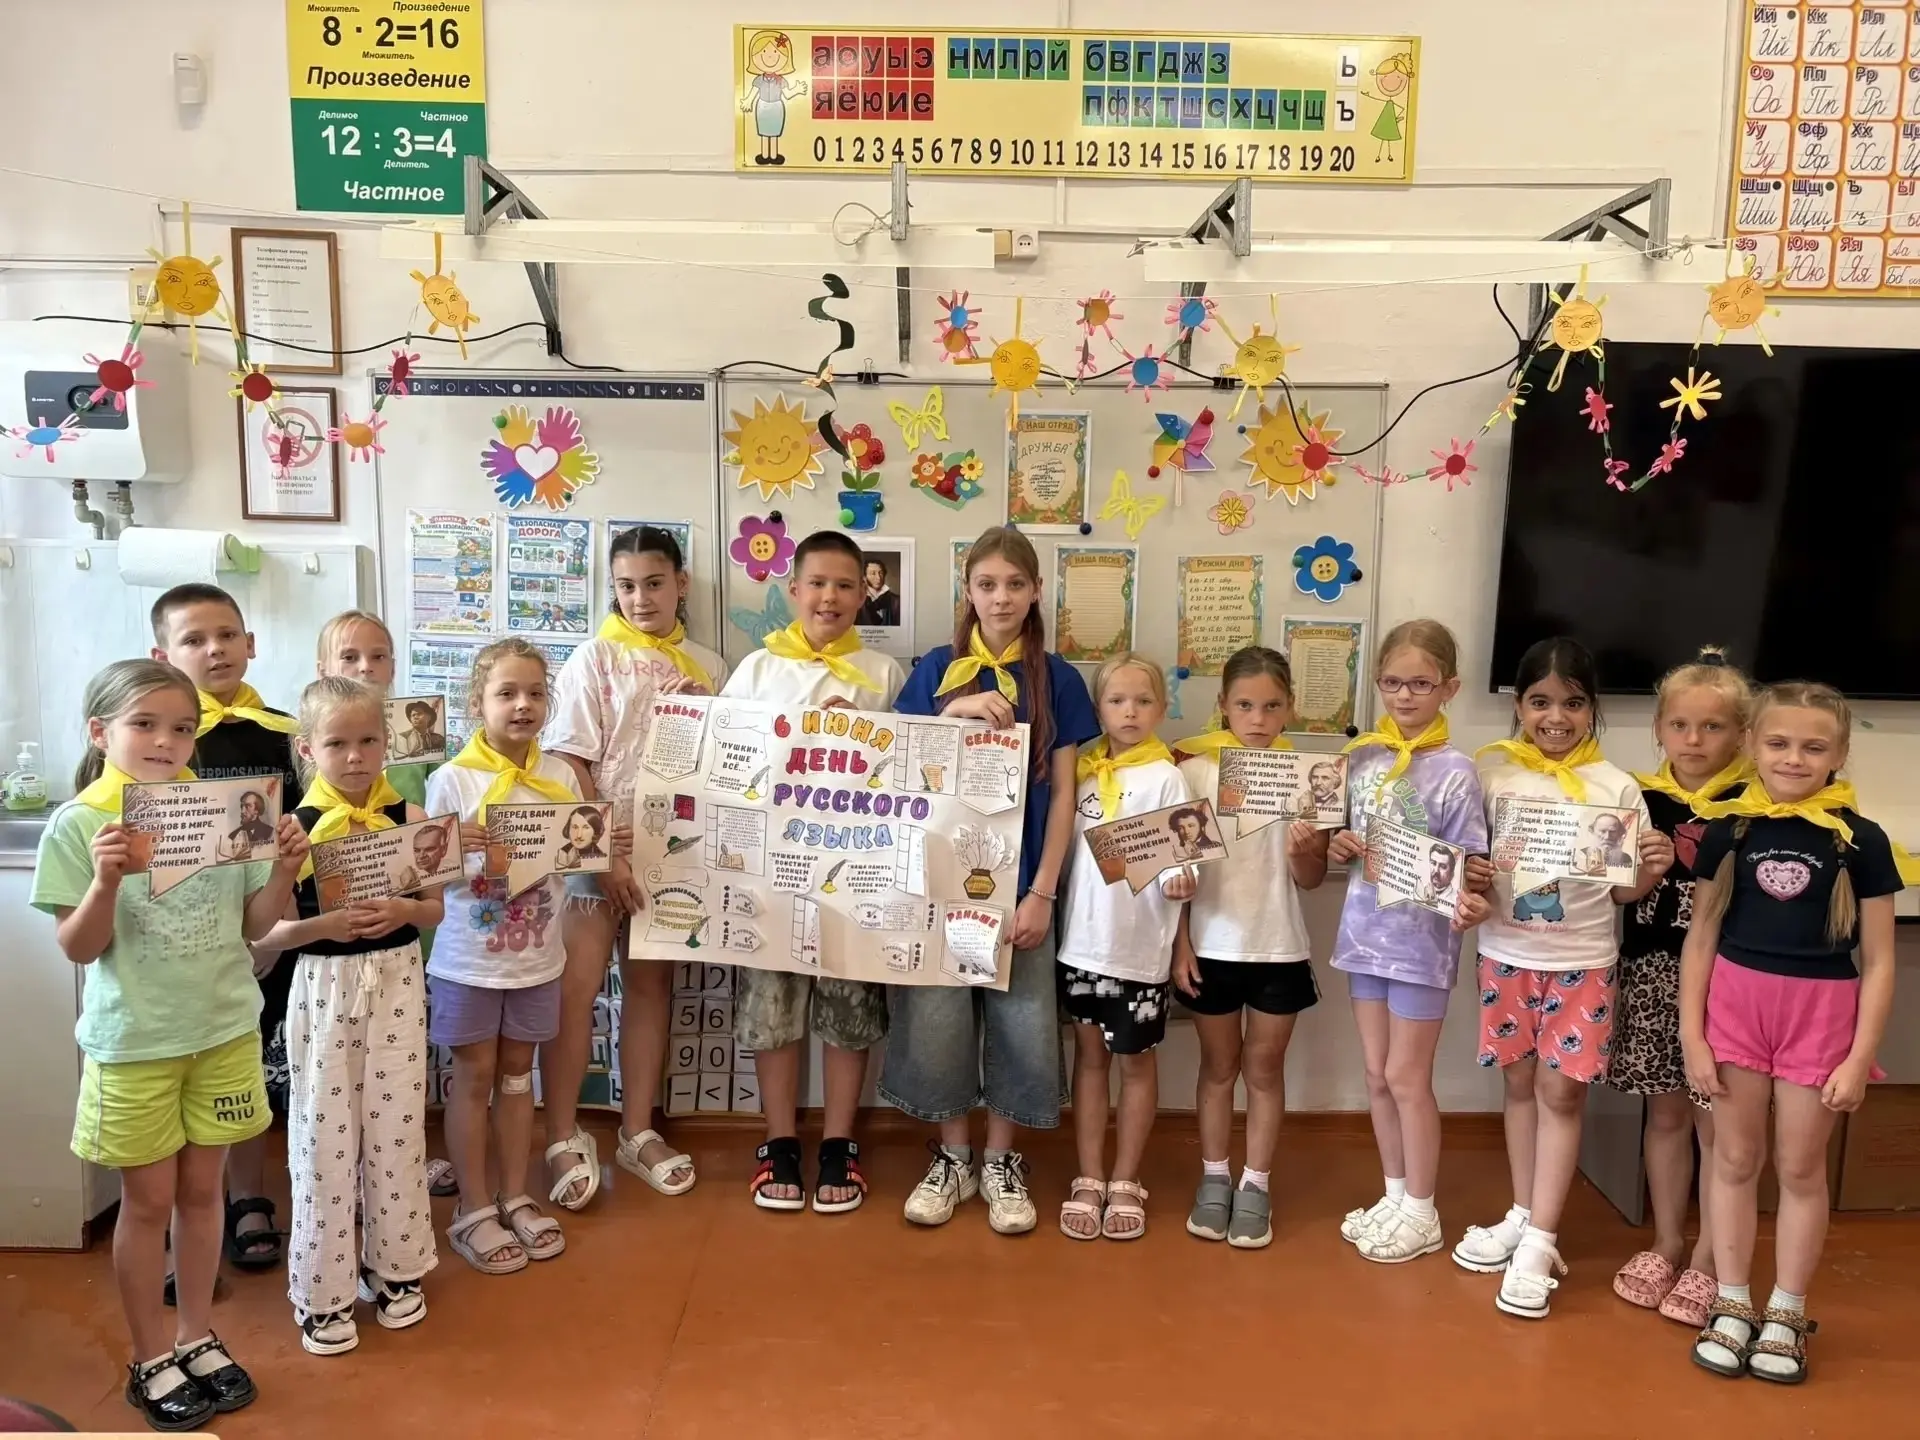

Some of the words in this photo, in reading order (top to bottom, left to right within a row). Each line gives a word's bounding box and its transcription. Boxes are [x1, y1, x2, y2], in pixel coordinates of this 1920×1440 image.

[307, 4, 360, 13] Множитель
[393, 1, 470, 13] Произведение
[1807, 9, 1828, 24] Кк
[1860, 11, 1885, 25] Лл
[322, 16, 342, 46] 8
[362, 51, 415, 60] Множитель
[307, 66, 470, 89] Произведение
[1750, 65, 1774, 80] Оо
[1804, 66, 1826, 81] Пп
[1856, 67, 1878, 84] Рр
[319, 110, 358, 120] Делимое
[420, 112, 469, 122] Частное
[1746, 122, 1767, 139] Уу
[1798, 123, 1828, 139] Фф
[1851, 123, 1873, 138] Хх
[321, 125, 361, 156] 12
[814, 136, 826, 161] 0
[835, 137, 844, 161] 1
[853, 138, 865, 162] 2
[873, 138, 884, 162] 3
[892, 138, 904, 162] 4
[912, 138, 923, 163] 5
[931, 138, 943, 163] 6
[951, 139, 962, 163] 7
[970, 139, 982, 164] 8
[989, 139, 1001, 164] 9
[1011, 139, 1034, 165] 10
[1043, 140, 1065, 165] 11
[1076, 141, 1098, 167] 12
[1107, 141, 1130, 168] 13
[1139, 142, 1162, 168] 14
[1172, 143, 1195, 169] 15
[1204, 144, 1226, 170] 16
[1235, 144, 1259, 170] 17
[1267, 145, 1290, 170] 18
[1299, 145, 1323, 171] 19
[1330, 146, 1355, 172] 20
[384, 159, 429, 169] Делитель
[344, 181, 445, 201] Частное
[1740, 179, 1771, 194] Шш
[1792, 180, 1823, 196] Щщ
[1787, 237, 1819, 251] Юю
[1840, 237, 1863, 251] Яя
[1026, 421, 1045, 429] НАШ
[1048, 421, 1073, 430] ОТРЯД
[515, 520, 562, 529] БЕЗОПАСНАЯ
[518, 528, 561, 538] ДОРОГА
[654, 705, 705, 721] РАНЬШЕ
[774, 714, 791, 738] 6
[802, 711, 895, 752] ИЮНЯ
[965, 730, 1020, 750] СЕЙЧАС
[726, 753, 751, 763] НАШЕ
[785, 748, 868, 775] ДЕНЬ
[137, 796, 179, 807] РУССКИЙ
[181, 797, 208, 805] ЯЗЫК
[773, 783, 930, 821] РУССКОГО
[169, 807, 226, 818] БОГАТЕЙШИХ
[530, 810, 556, 818] ВАМИ
[139, 823, 179, 832] ЯЗЫКОВ
[498, 824, 542, 834] ГРОМАДА
[783, 819, 893, 849] ЯЗЫКА
[159, 834, 185, 843] ЭТОМ
[188, 833, 205, 841] НЕТ
[503, 835, 545, 846] РУССКИЙ
[153, 846, 201, 856] НИКАКОГО
[946, 909, 999, 929] РАНЬШЕ
[680, 1005, 696, 1026] 5
[709, 1009, 724, 1028] 6
[679, 1046, 695, 1067] 9
[710, 1047, 724, 1067] 0
